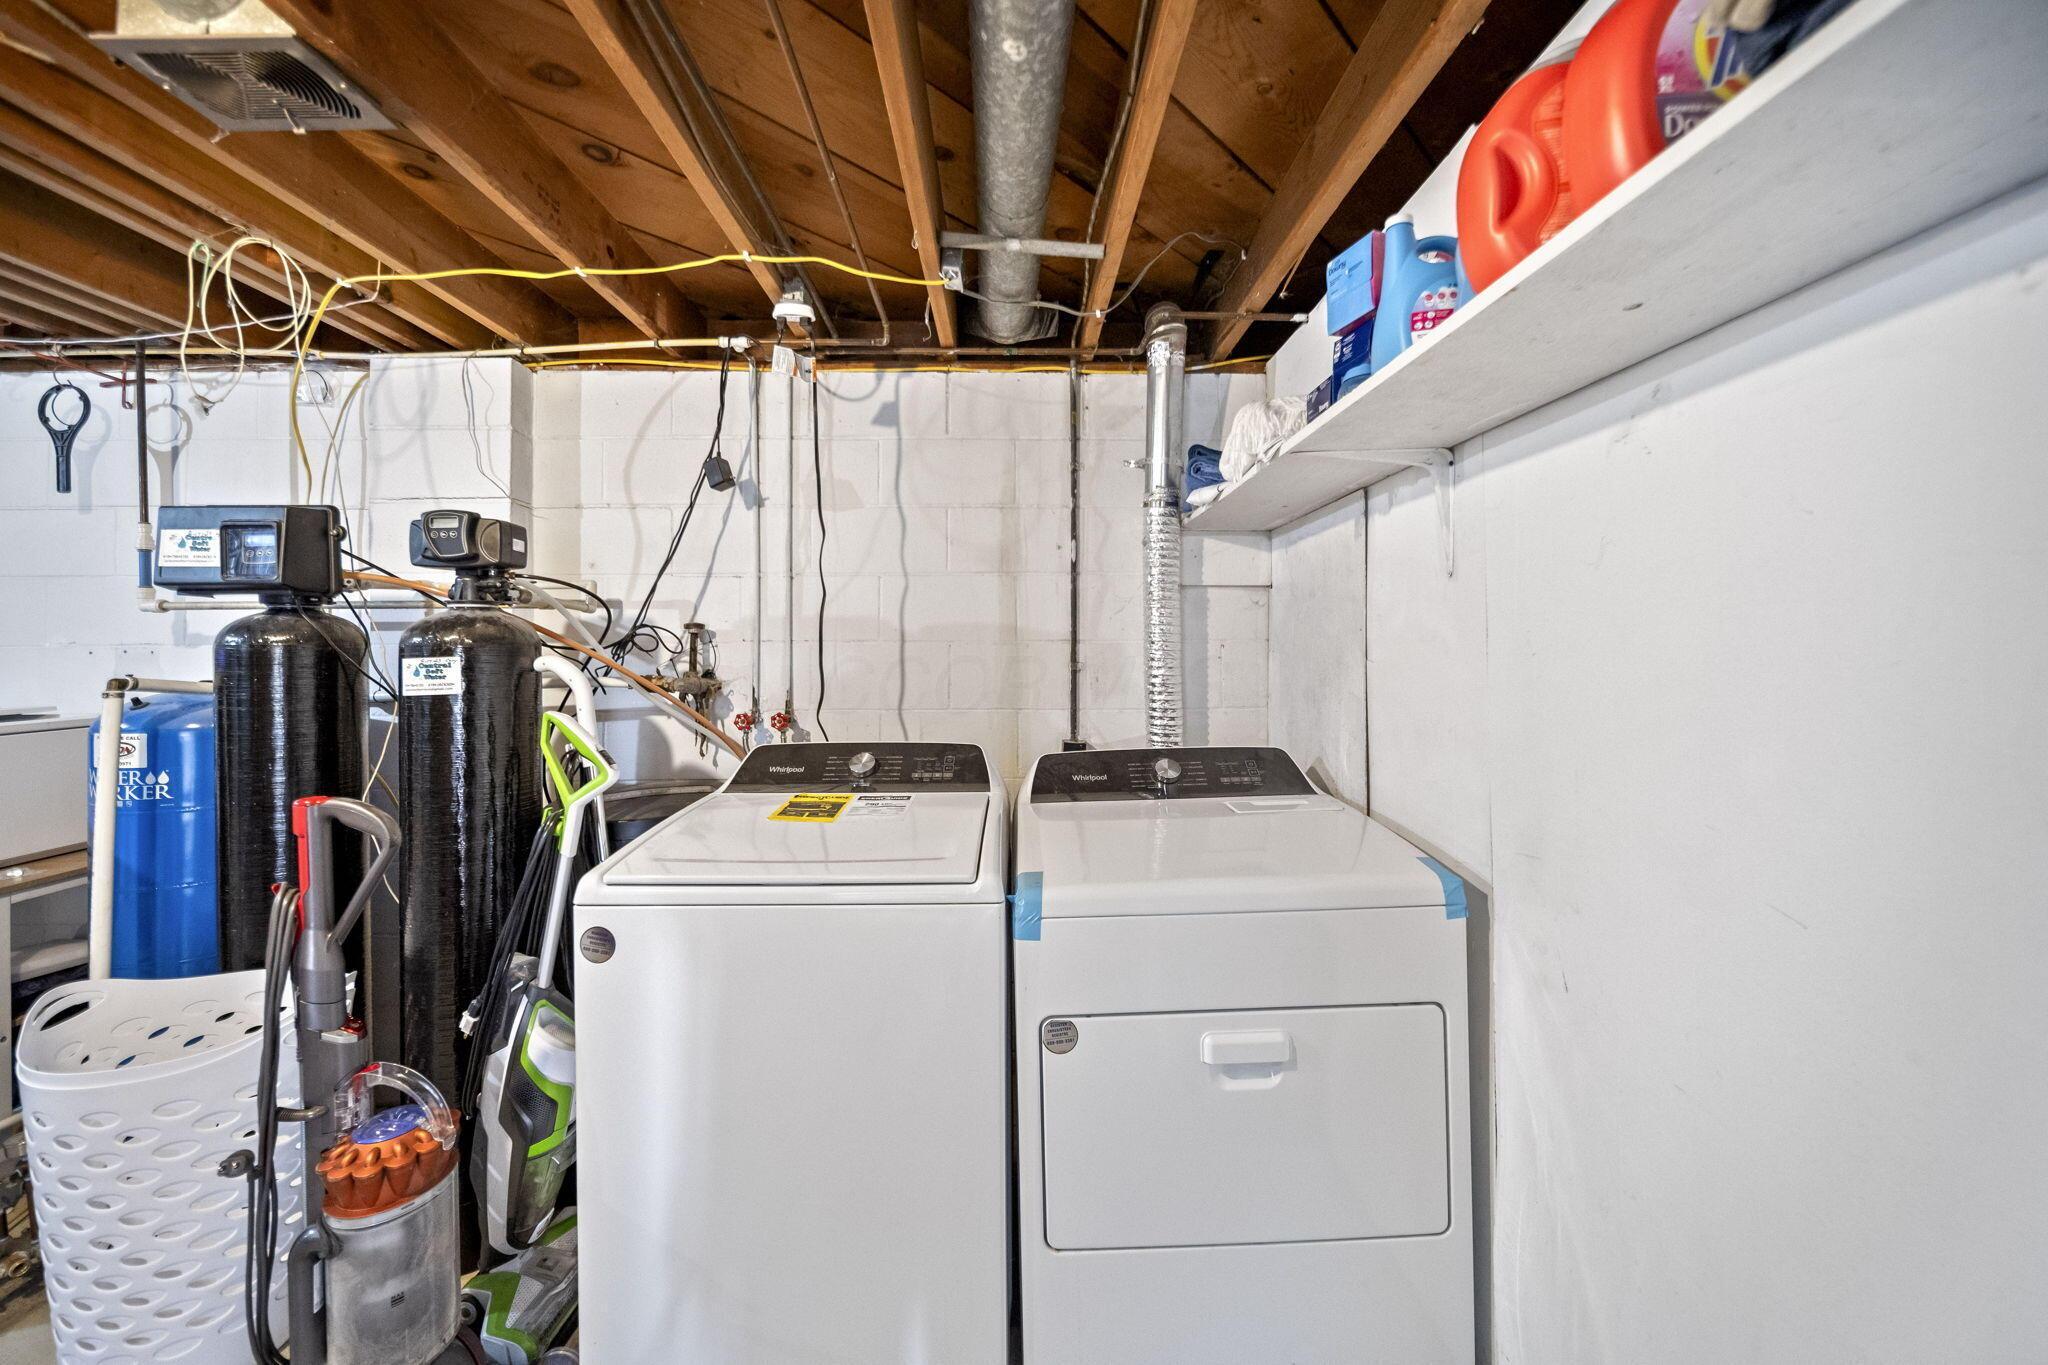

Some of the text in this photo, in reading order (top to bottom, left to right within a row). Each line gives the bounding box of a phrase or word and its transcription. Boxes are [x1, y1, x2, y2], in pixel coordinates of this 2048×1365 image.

[769, 765, 805, 774] Whirlpool
[89, 768, 145, 786] WER
[1072, 773, 1108, 782] Whirlpool
